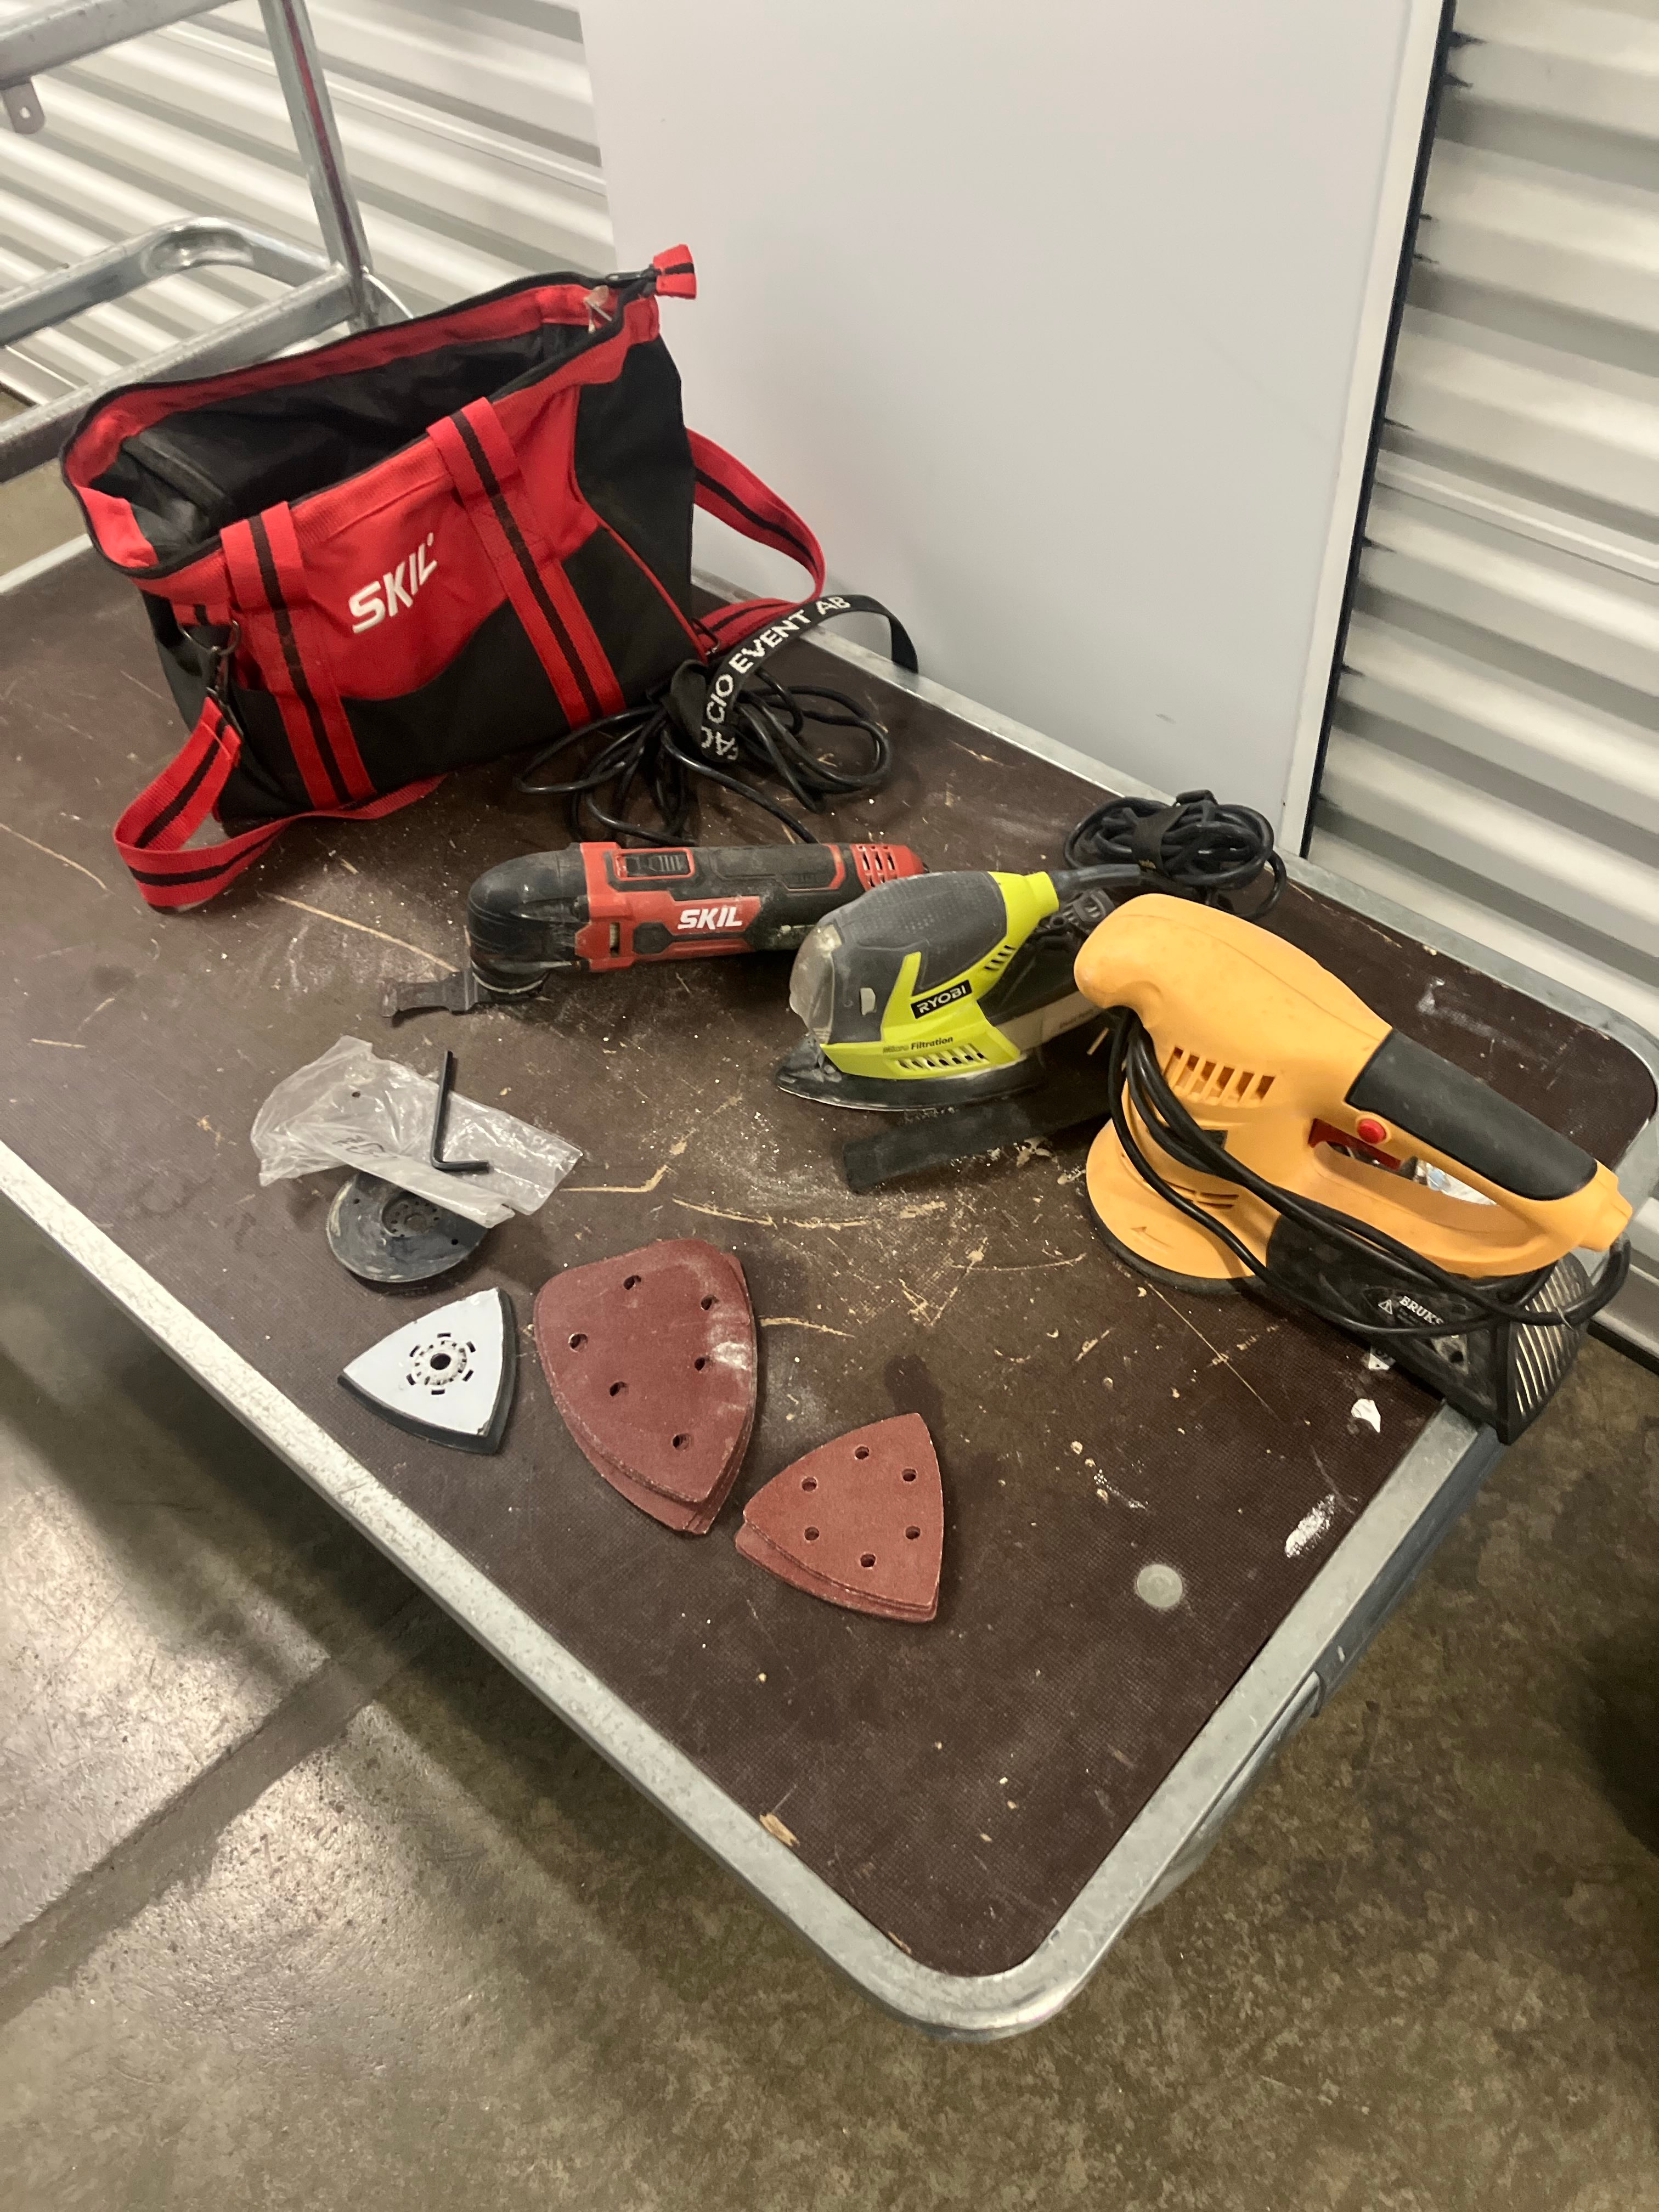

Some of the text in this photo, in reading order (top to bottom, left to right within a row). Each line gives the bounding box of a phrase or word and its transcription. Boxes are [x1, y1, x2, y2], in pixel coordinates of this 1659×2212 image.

[348, 543, 437, 634] SKIL
[728, 608, 812, 674] EVENT
[815, 596, 851, 616] AB
[677, 906, 743, 930] SKIL
[917, 985, 967, 1014] RYOBI
[911, 1036, 953, 1050] Filtration
